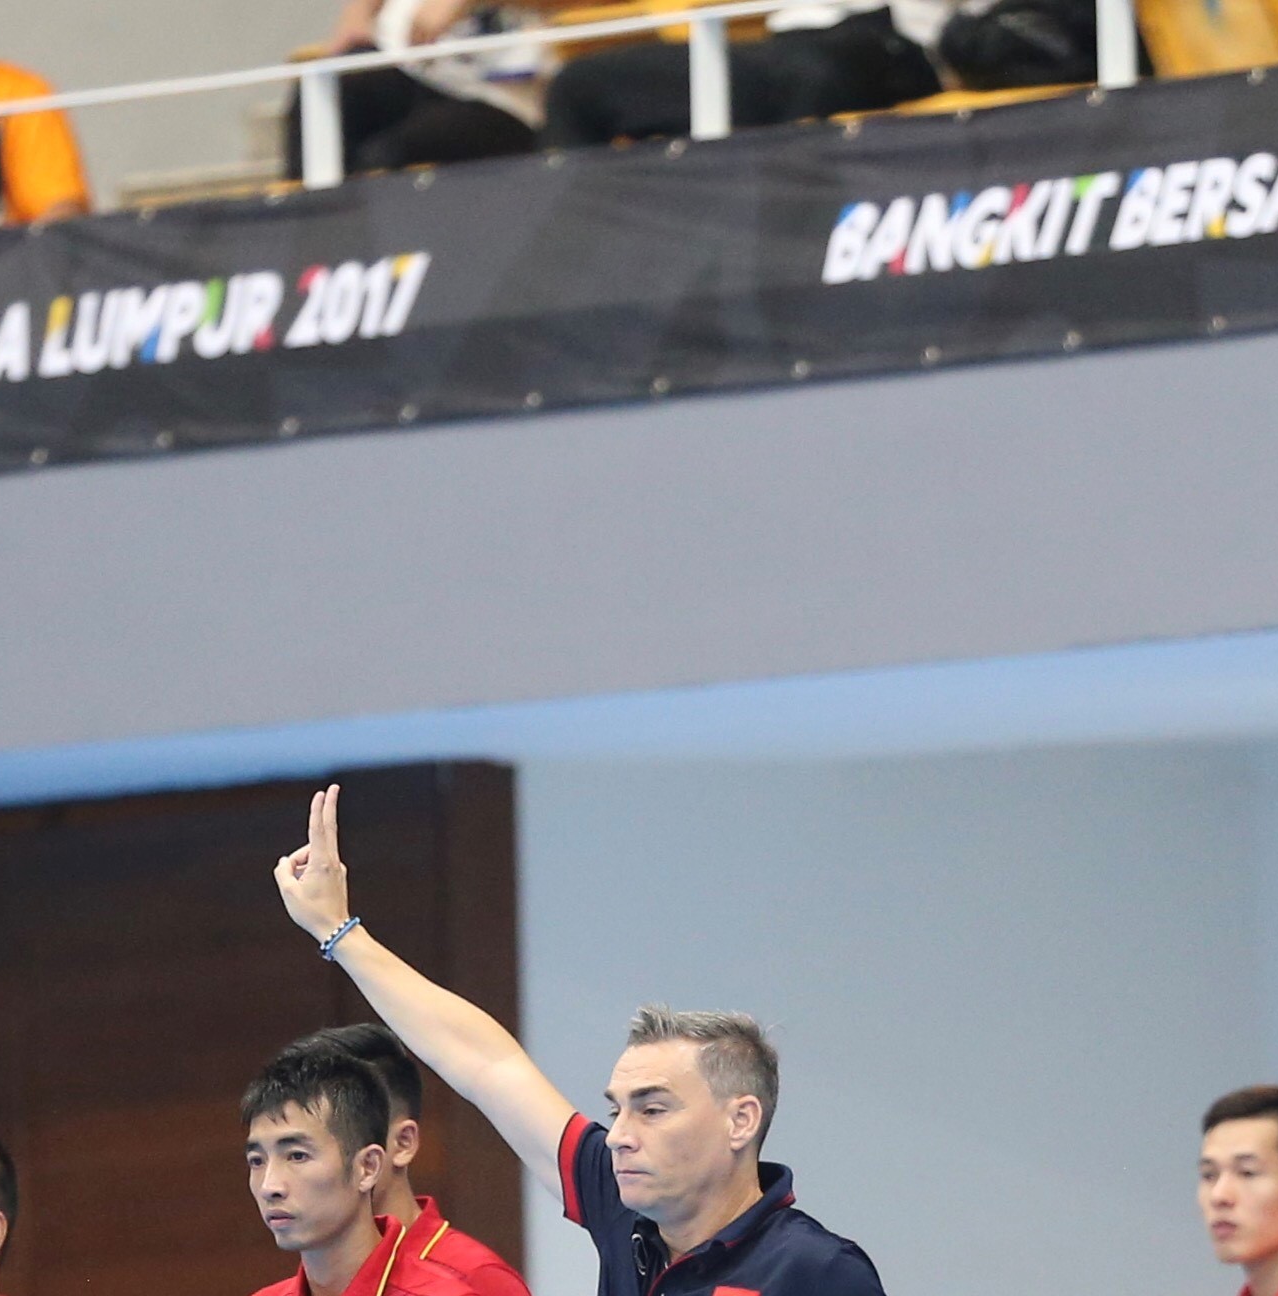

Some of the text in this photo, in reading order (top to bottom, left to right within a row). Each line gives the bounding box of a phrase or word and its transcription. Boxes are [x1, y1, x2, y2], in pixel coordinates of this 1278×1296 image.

[821, 171, 1121, 286] BANGKIT
[38, 270, 285, 380] LUMPUR
[283, 250, 432, 350] 2017
